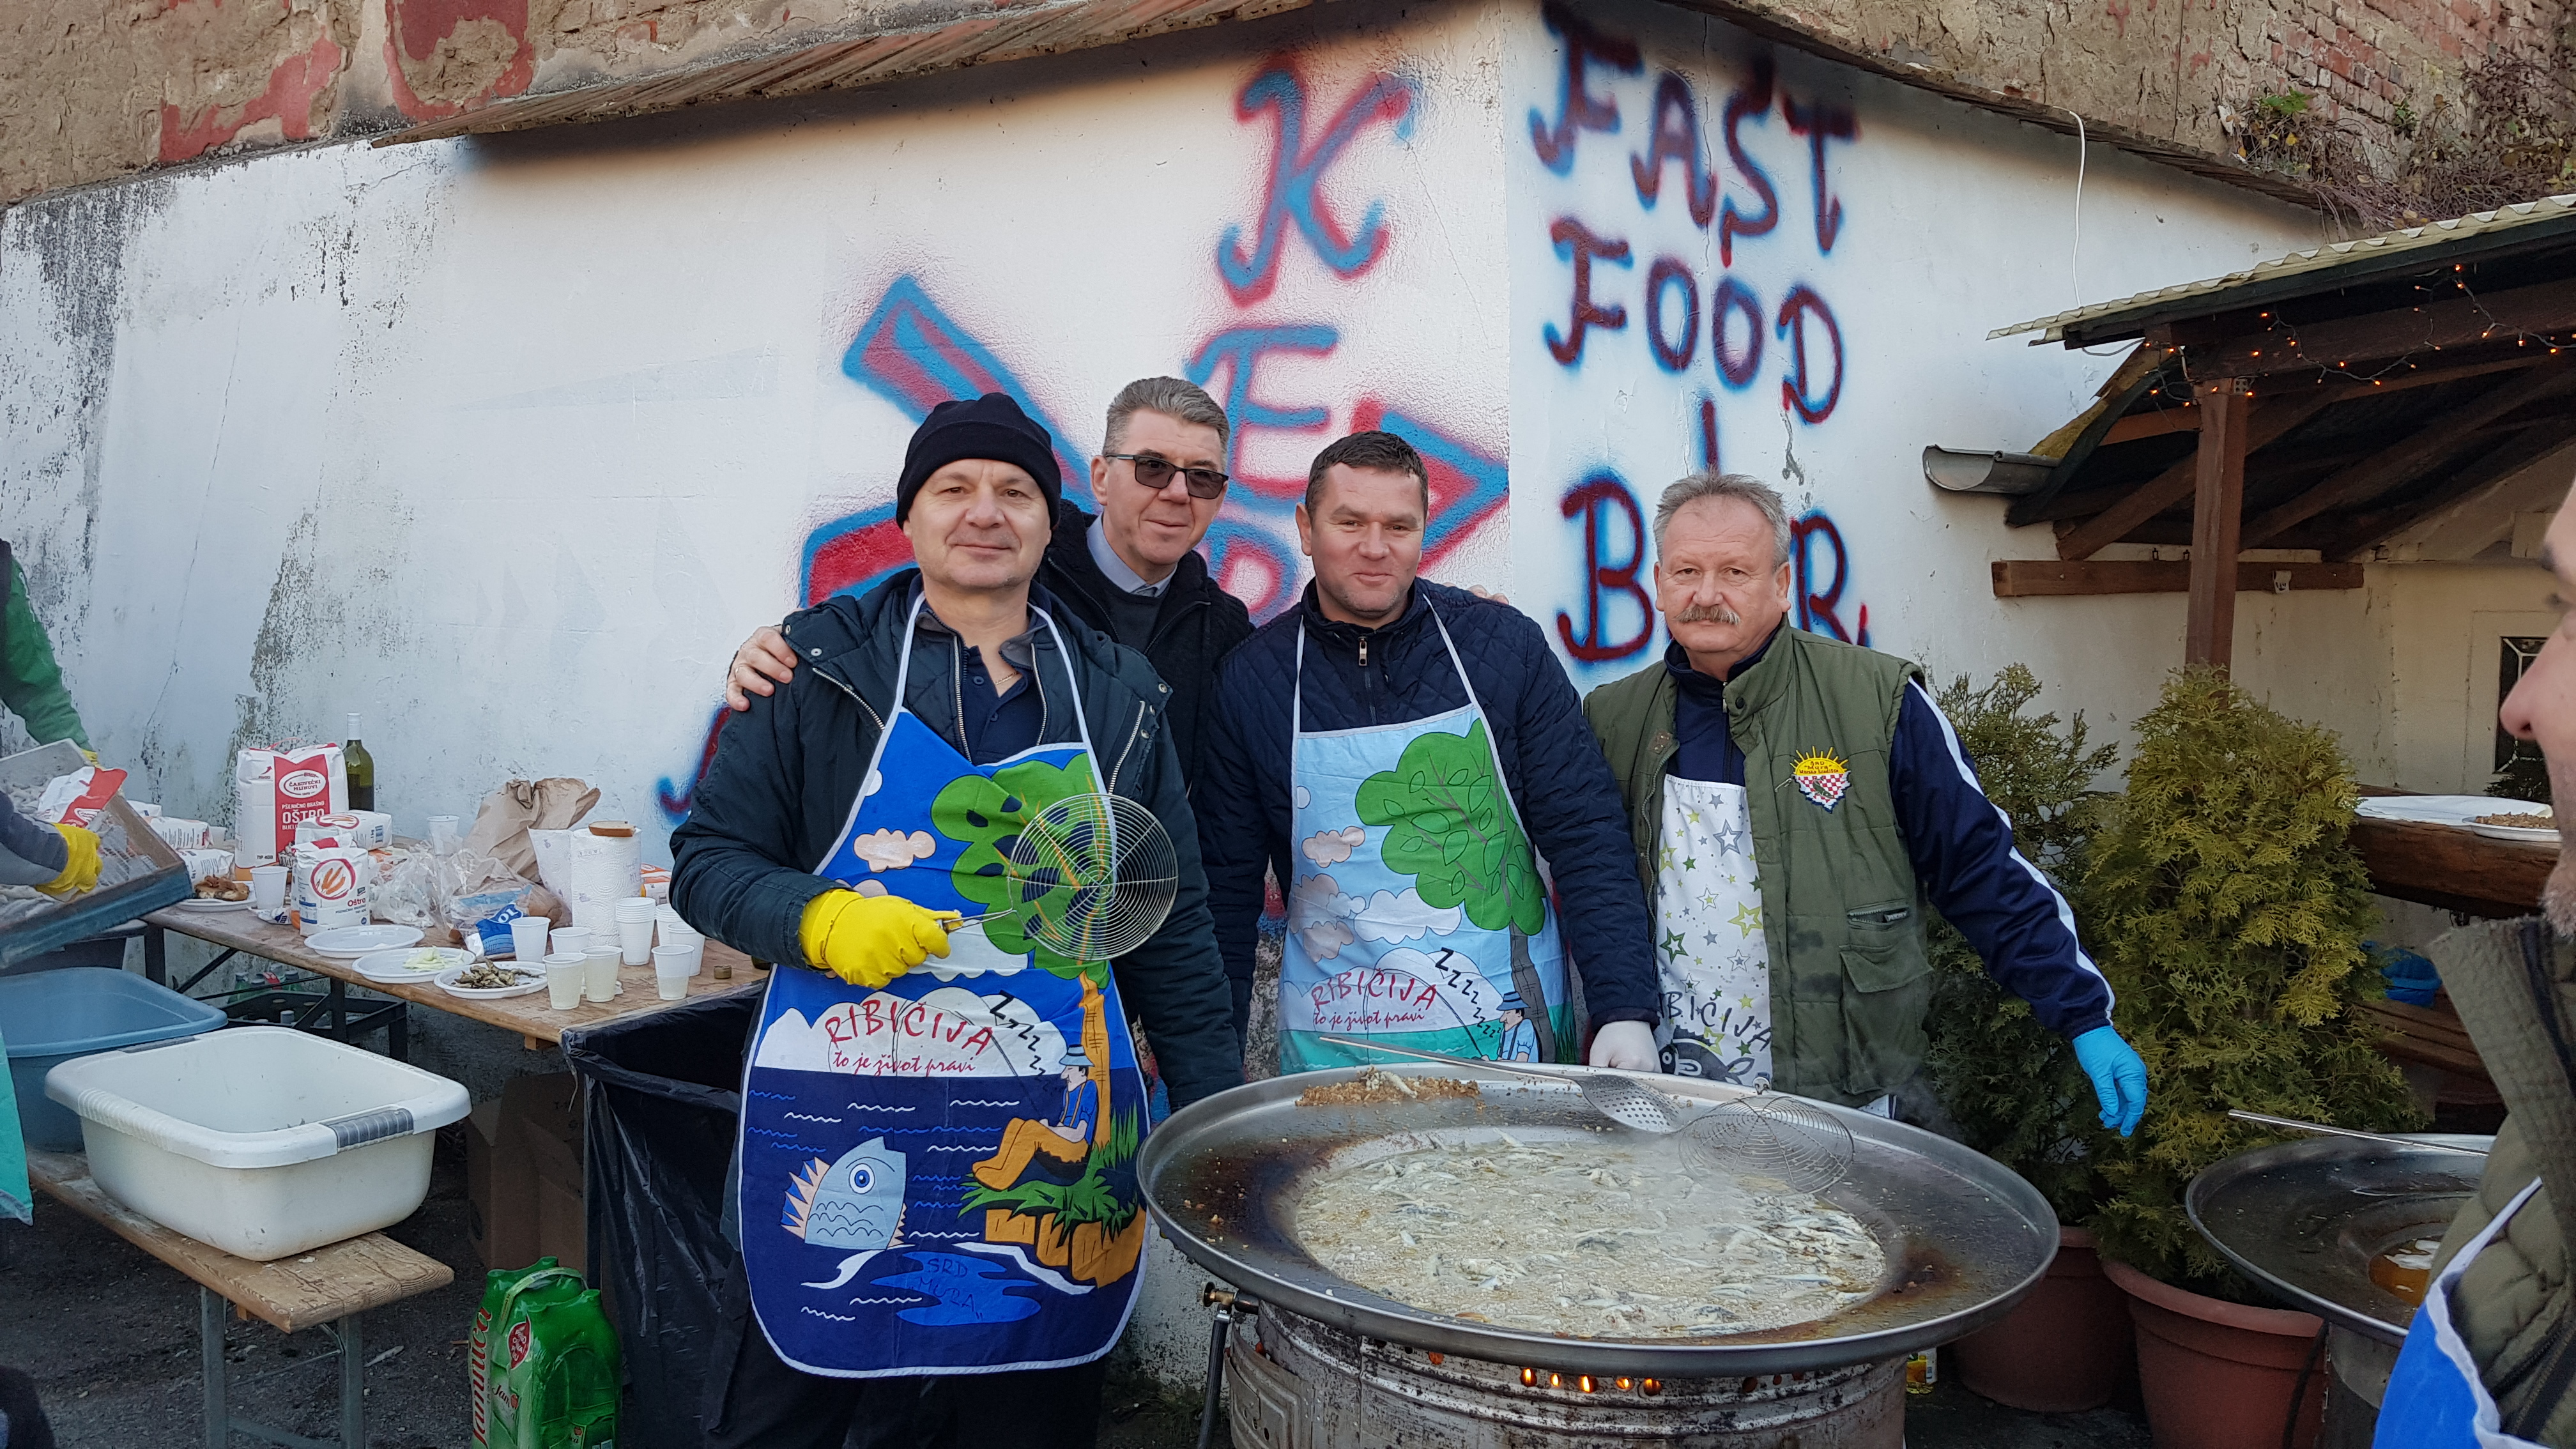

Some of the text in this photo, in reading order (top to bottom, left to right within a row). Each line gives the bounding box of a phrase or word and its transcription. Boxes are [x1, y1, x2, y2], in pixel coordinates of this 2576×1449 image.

[1528, 4, 1863, 268] FAST
[1542, 216, 1846, 425] FOOD
[1555, 466, 1871, 666] BR
[1312, 968, 1437, 1012] RIBIČIJA
[1314, 1008, 1425, 1031] to je život pravi
[825, 999, 993, 1056] RIBIČIJA
[1659, 991, 1772, 1052] IBIČIJA
[832, 1050, 976, 1078] to je život pravi
[927, 1258, 969, 1278] SRD
[471, 1307, 493, 1449] Jamnica
